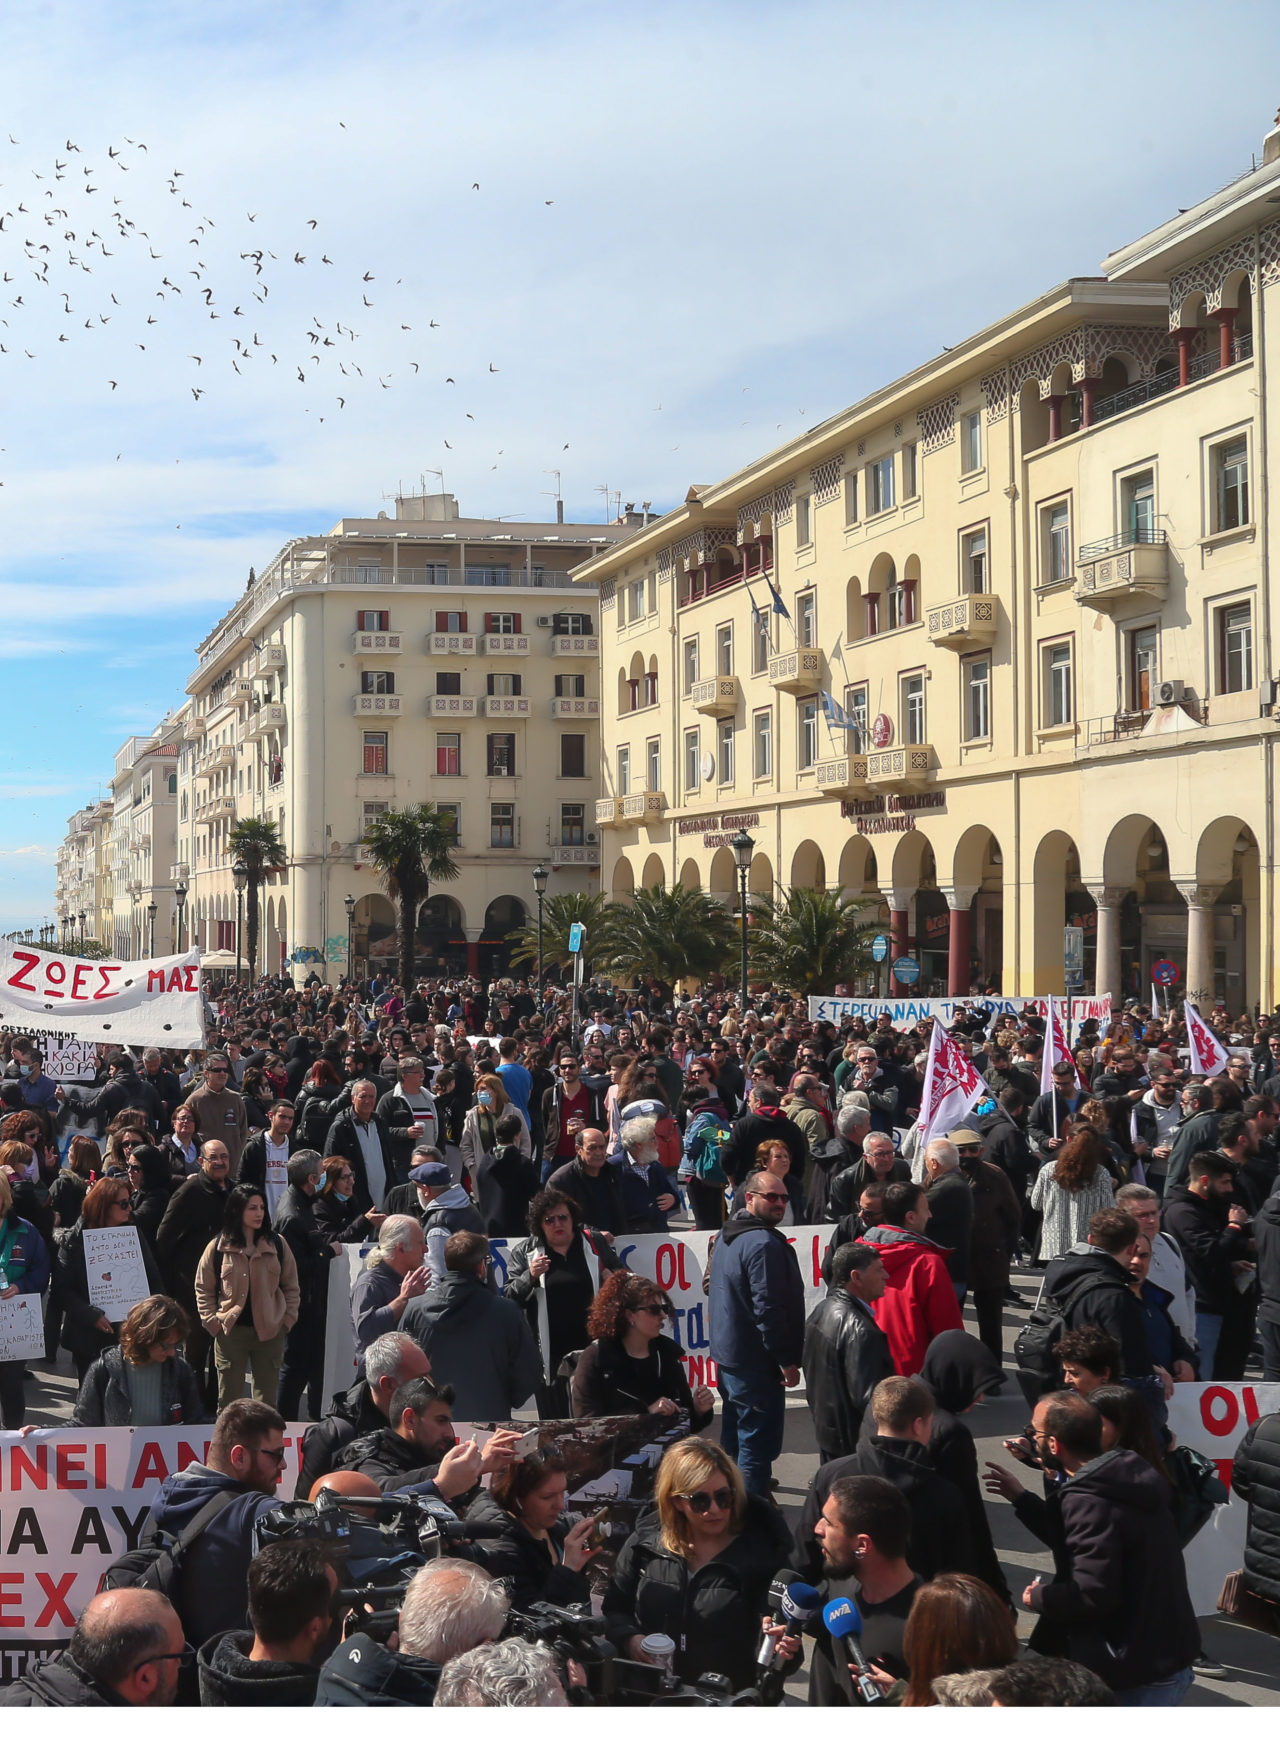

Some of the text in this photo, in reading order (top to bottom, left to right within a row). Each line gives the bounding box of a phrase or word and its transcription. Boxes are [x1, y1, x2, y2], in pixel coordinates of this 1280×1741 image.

[7, 951, 122, 1000] ΖΩΕΣ
[147, 965, 199, 993] ΜΑΣ
[1, 1024, 78, 1040] ΘΕΣΣΑΛΟΝΙΚΗΣ
[52, 1051, 96, 1062] ΚΑΚΙΑ
[70, 1504, 151, 1555] ΑΥ
